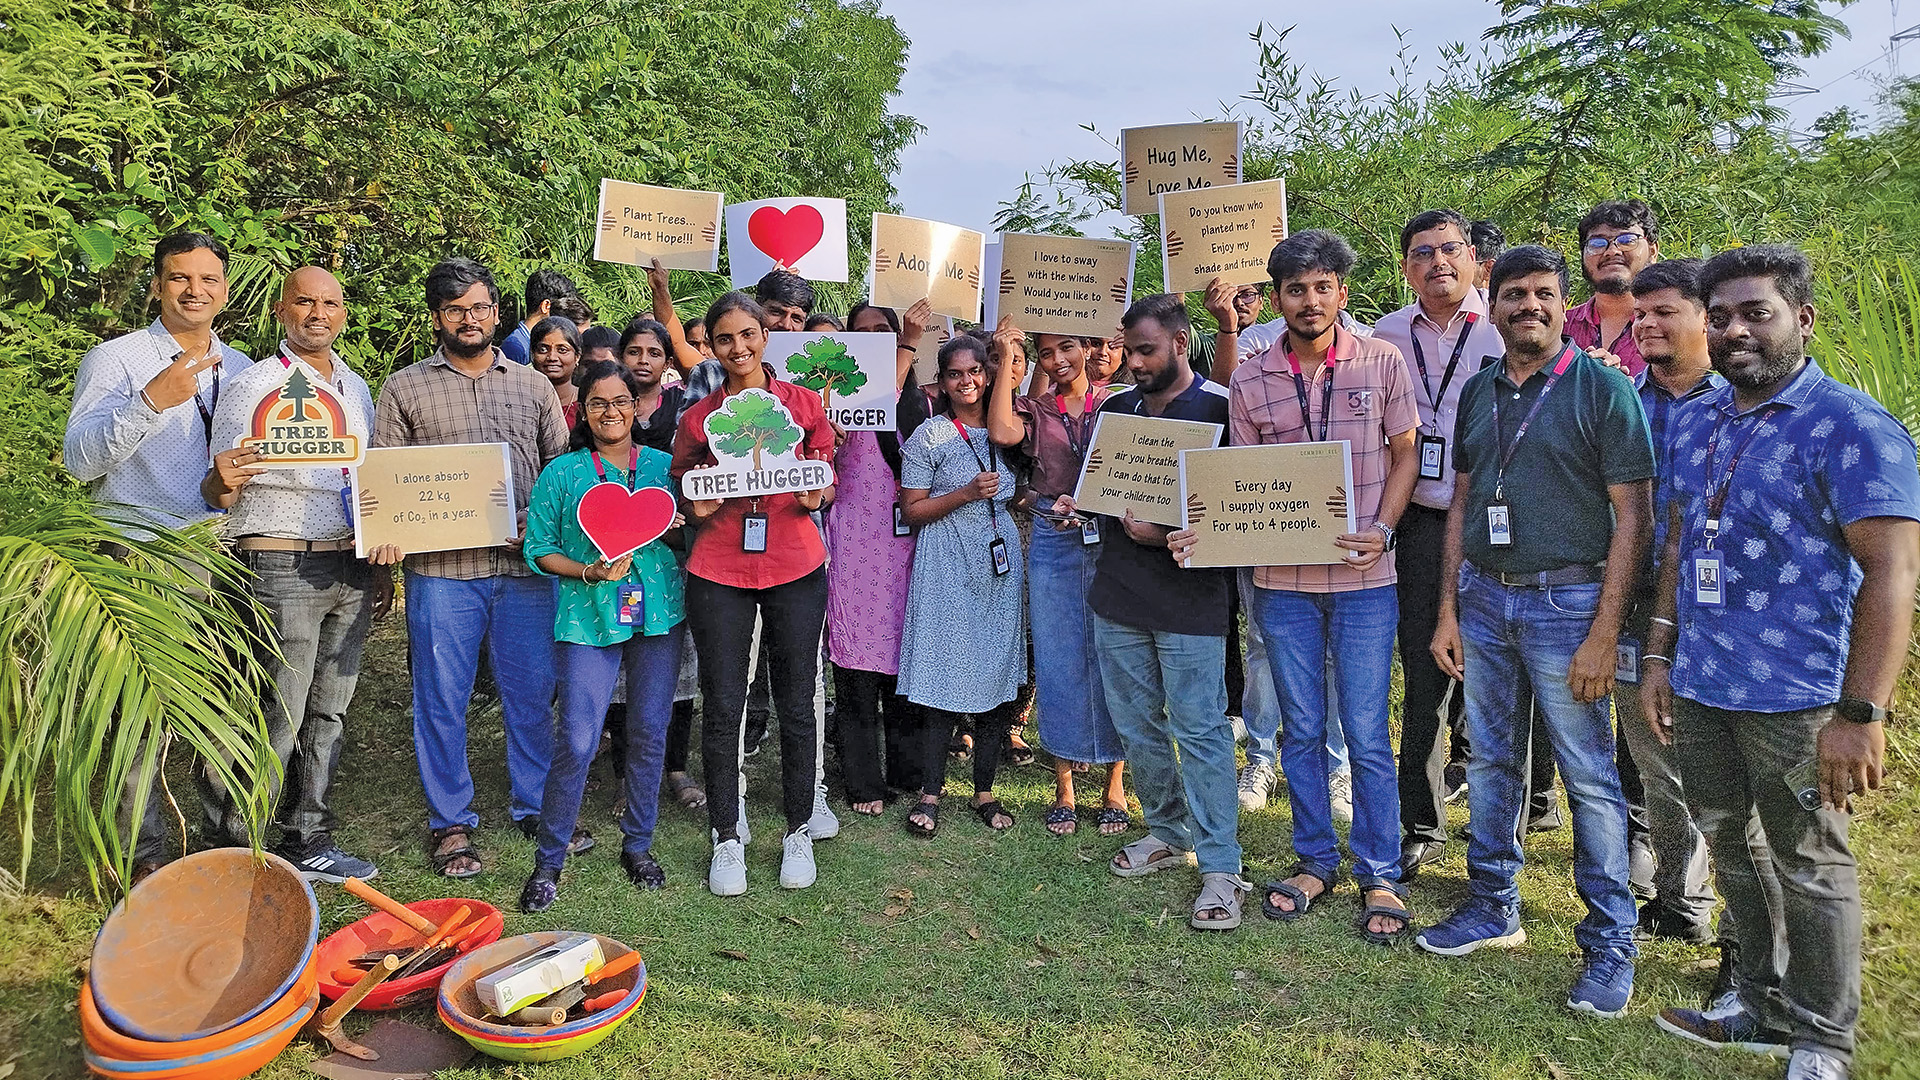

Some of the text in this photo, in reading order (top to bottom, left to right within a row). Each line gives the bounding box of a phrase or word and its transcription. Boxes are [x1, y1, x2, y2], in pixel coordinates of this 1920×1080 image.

[1147, 144, 1212, 167] Hug Me,
[1147, 179, 1182, 196] Love
[623, 207, 696, 226] Plant Trees...
[1189, 200, 1264, 219] Do you know who
[622, 226, 693, 246] Plant Hope!!!
[1201, 218, 1256, 238] planted me ?
[1211, 241, 1250, 255] Enjoy my
[896, 251, 964, 281] Adop Me
[1034, 250, 1098, 268] I love to sway
[1194, 257, 1266, 275] shade and fruits.
[1027, 269, 1098, 284] with the winds.
[1023, 286, 1102, 302] Would you like to
[1024, 304, 1098, 319] sing under me ?
[922, 324, 941, 333] llion
[825, 408, 886, 426] UGGER
[270, 426, 329, 440] TREE
[1132, 433, 1175, 448] I clean the
[1114, 450, 1128, 461] air
[1128, 454, 1145, 465] you
[395, 469, 470, 484] I alone absorb
[690, 465, 826, 496] TREE HUGGER
[1108, 466, 1177, 486] I can do that for
[1234, 479, 1292, 494] Every day
[418, 490, 451, 503] 22 kg
[1100, 487, 1171, 506] your children too
[1221, 499, 1310, 514] I supply oxygen
[393, 511, 404, 523] of
[428, 509, 439, 521] in
[442, 511, 449, 520] a
[451, 509, 478, 522] year.
[1212, 517, 1321, 534] For up to 4 people.
